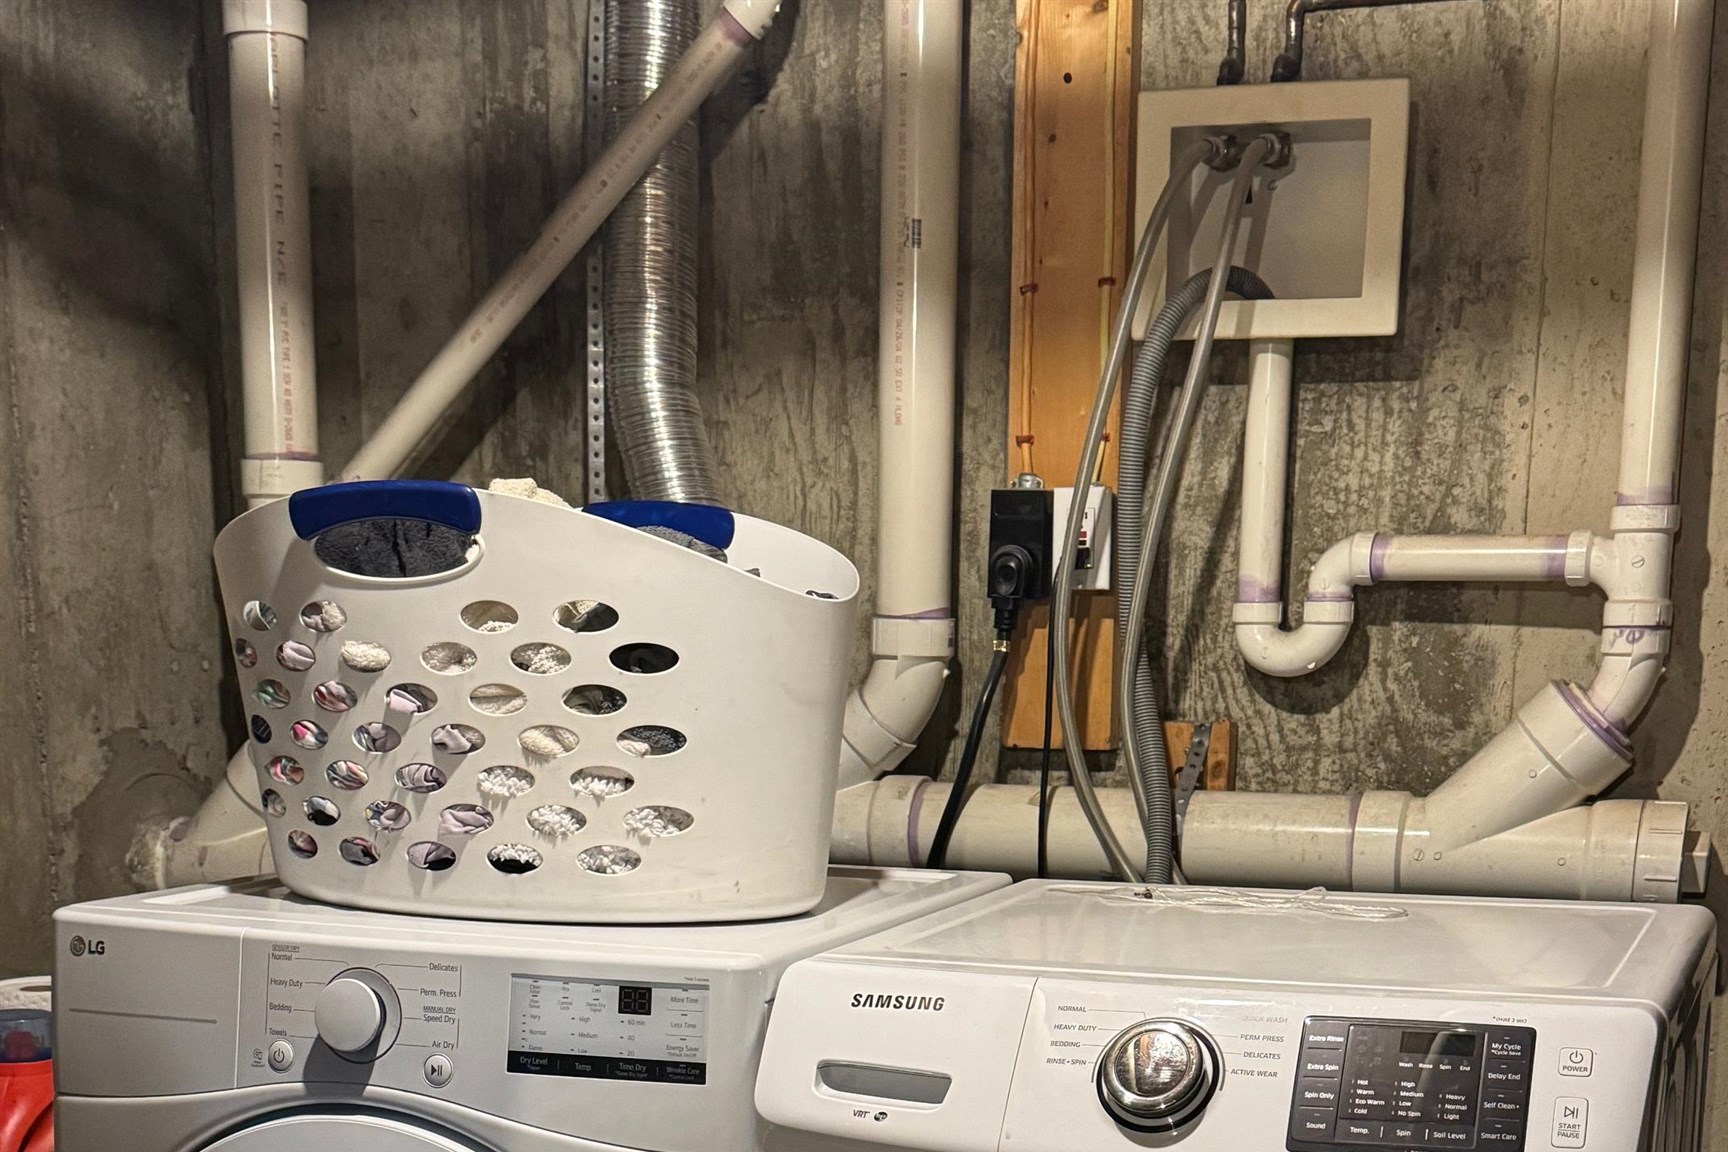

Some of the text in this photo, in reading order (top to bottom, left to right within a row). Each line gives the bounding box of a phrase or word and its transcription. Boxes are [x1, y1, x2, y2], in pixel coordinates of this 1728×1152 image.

[88, 940, 105, 955] LG
[429, 962, 458, 972] Delicates
[270, 978, 304, 988] Heavy Duty
[440, 990, 457, 998] Press
[270, 1002, 292, 1013] Bedding
[851, 994, 945, 1011] SAMSUNG
[423, 1014, 456, 1024] Speed Dry
[269, 1028, 288, 1036] Towels
[432, 1040, 454, 1050] Air Dry
[520, 1056, 548, 1066] Dry Level
[1243, 1052, 1281, 1060] DELICATES
[620, 1062, 647, 1072] Time Dry
[1488, 1072, 1506, 1081] Delay
[1350, 1126, 1370, 1134] Temp.
[1396, 1129, 1412, 1137] Spin
